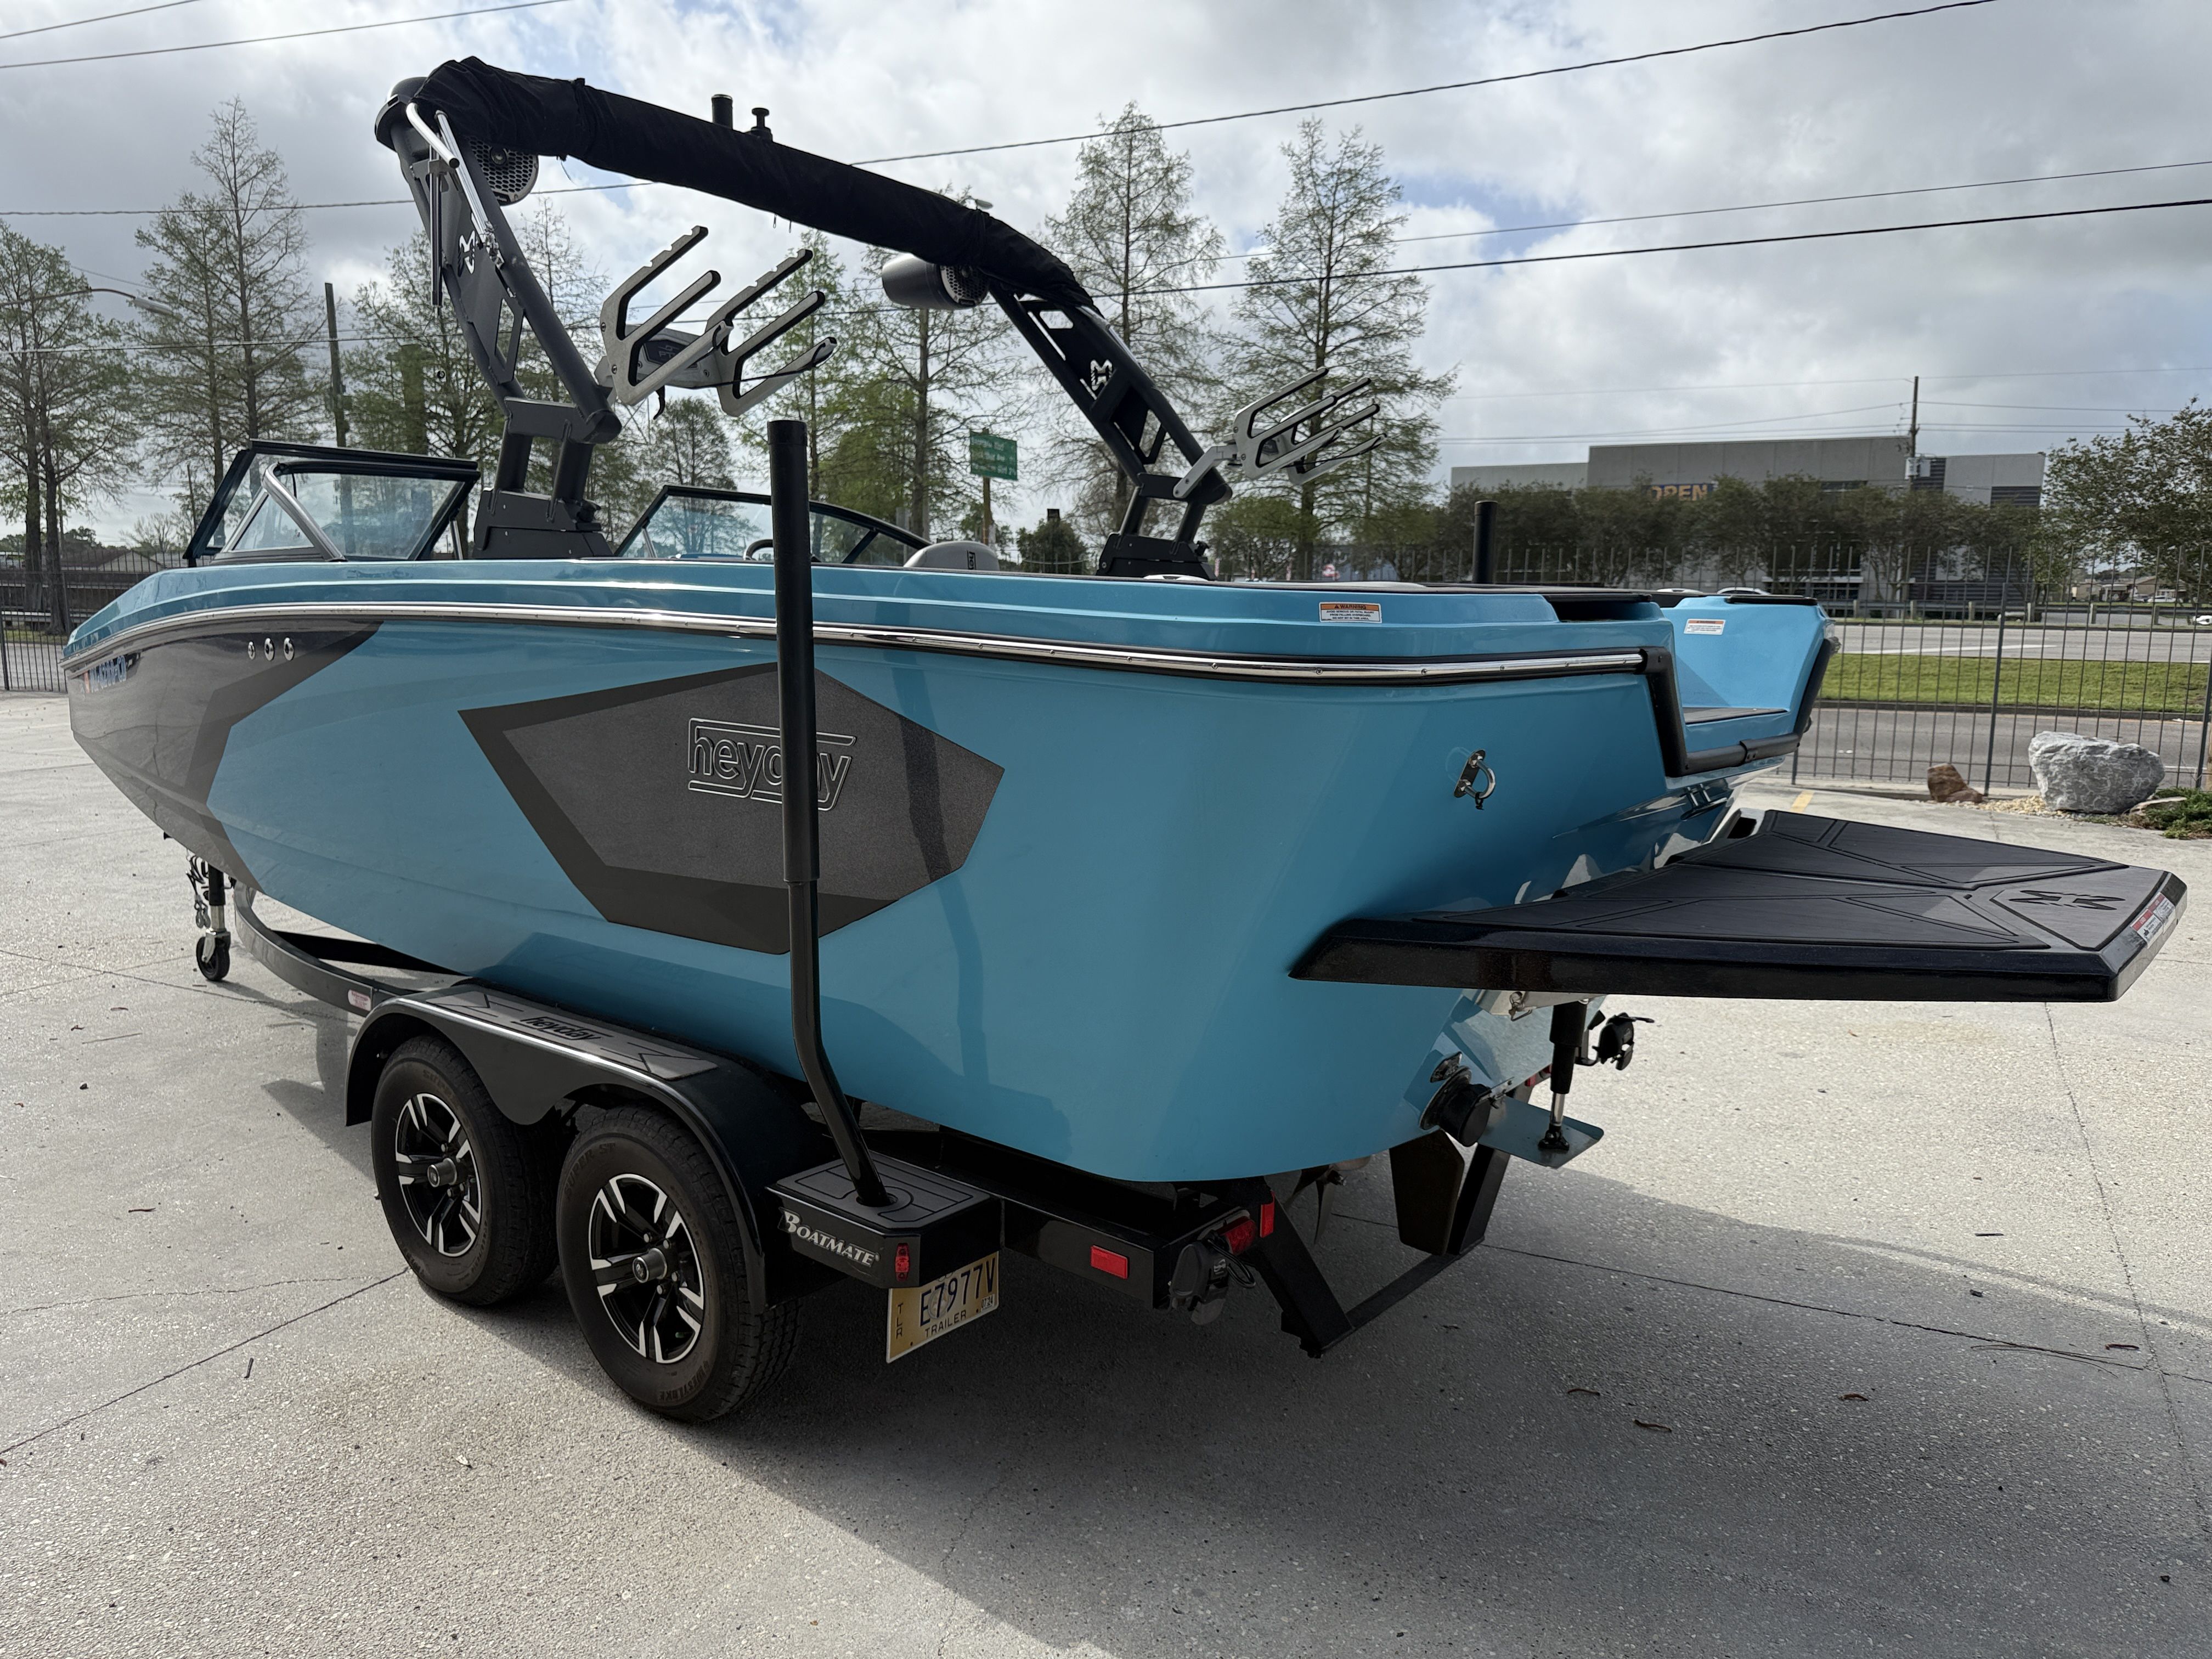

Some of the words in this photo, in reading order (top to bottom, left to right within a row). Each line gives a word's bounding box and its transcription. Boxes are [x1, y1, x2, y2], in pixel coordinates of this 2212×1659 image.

[688, 718, 856, 811] heyy
[518, 1017, 610, 1040] heyday
[783, 1210, 876, 1268] BOATMATE
[920, 1257, 994, 1327] E7977V
[924, 1309, 967, 1338] TRAILER
